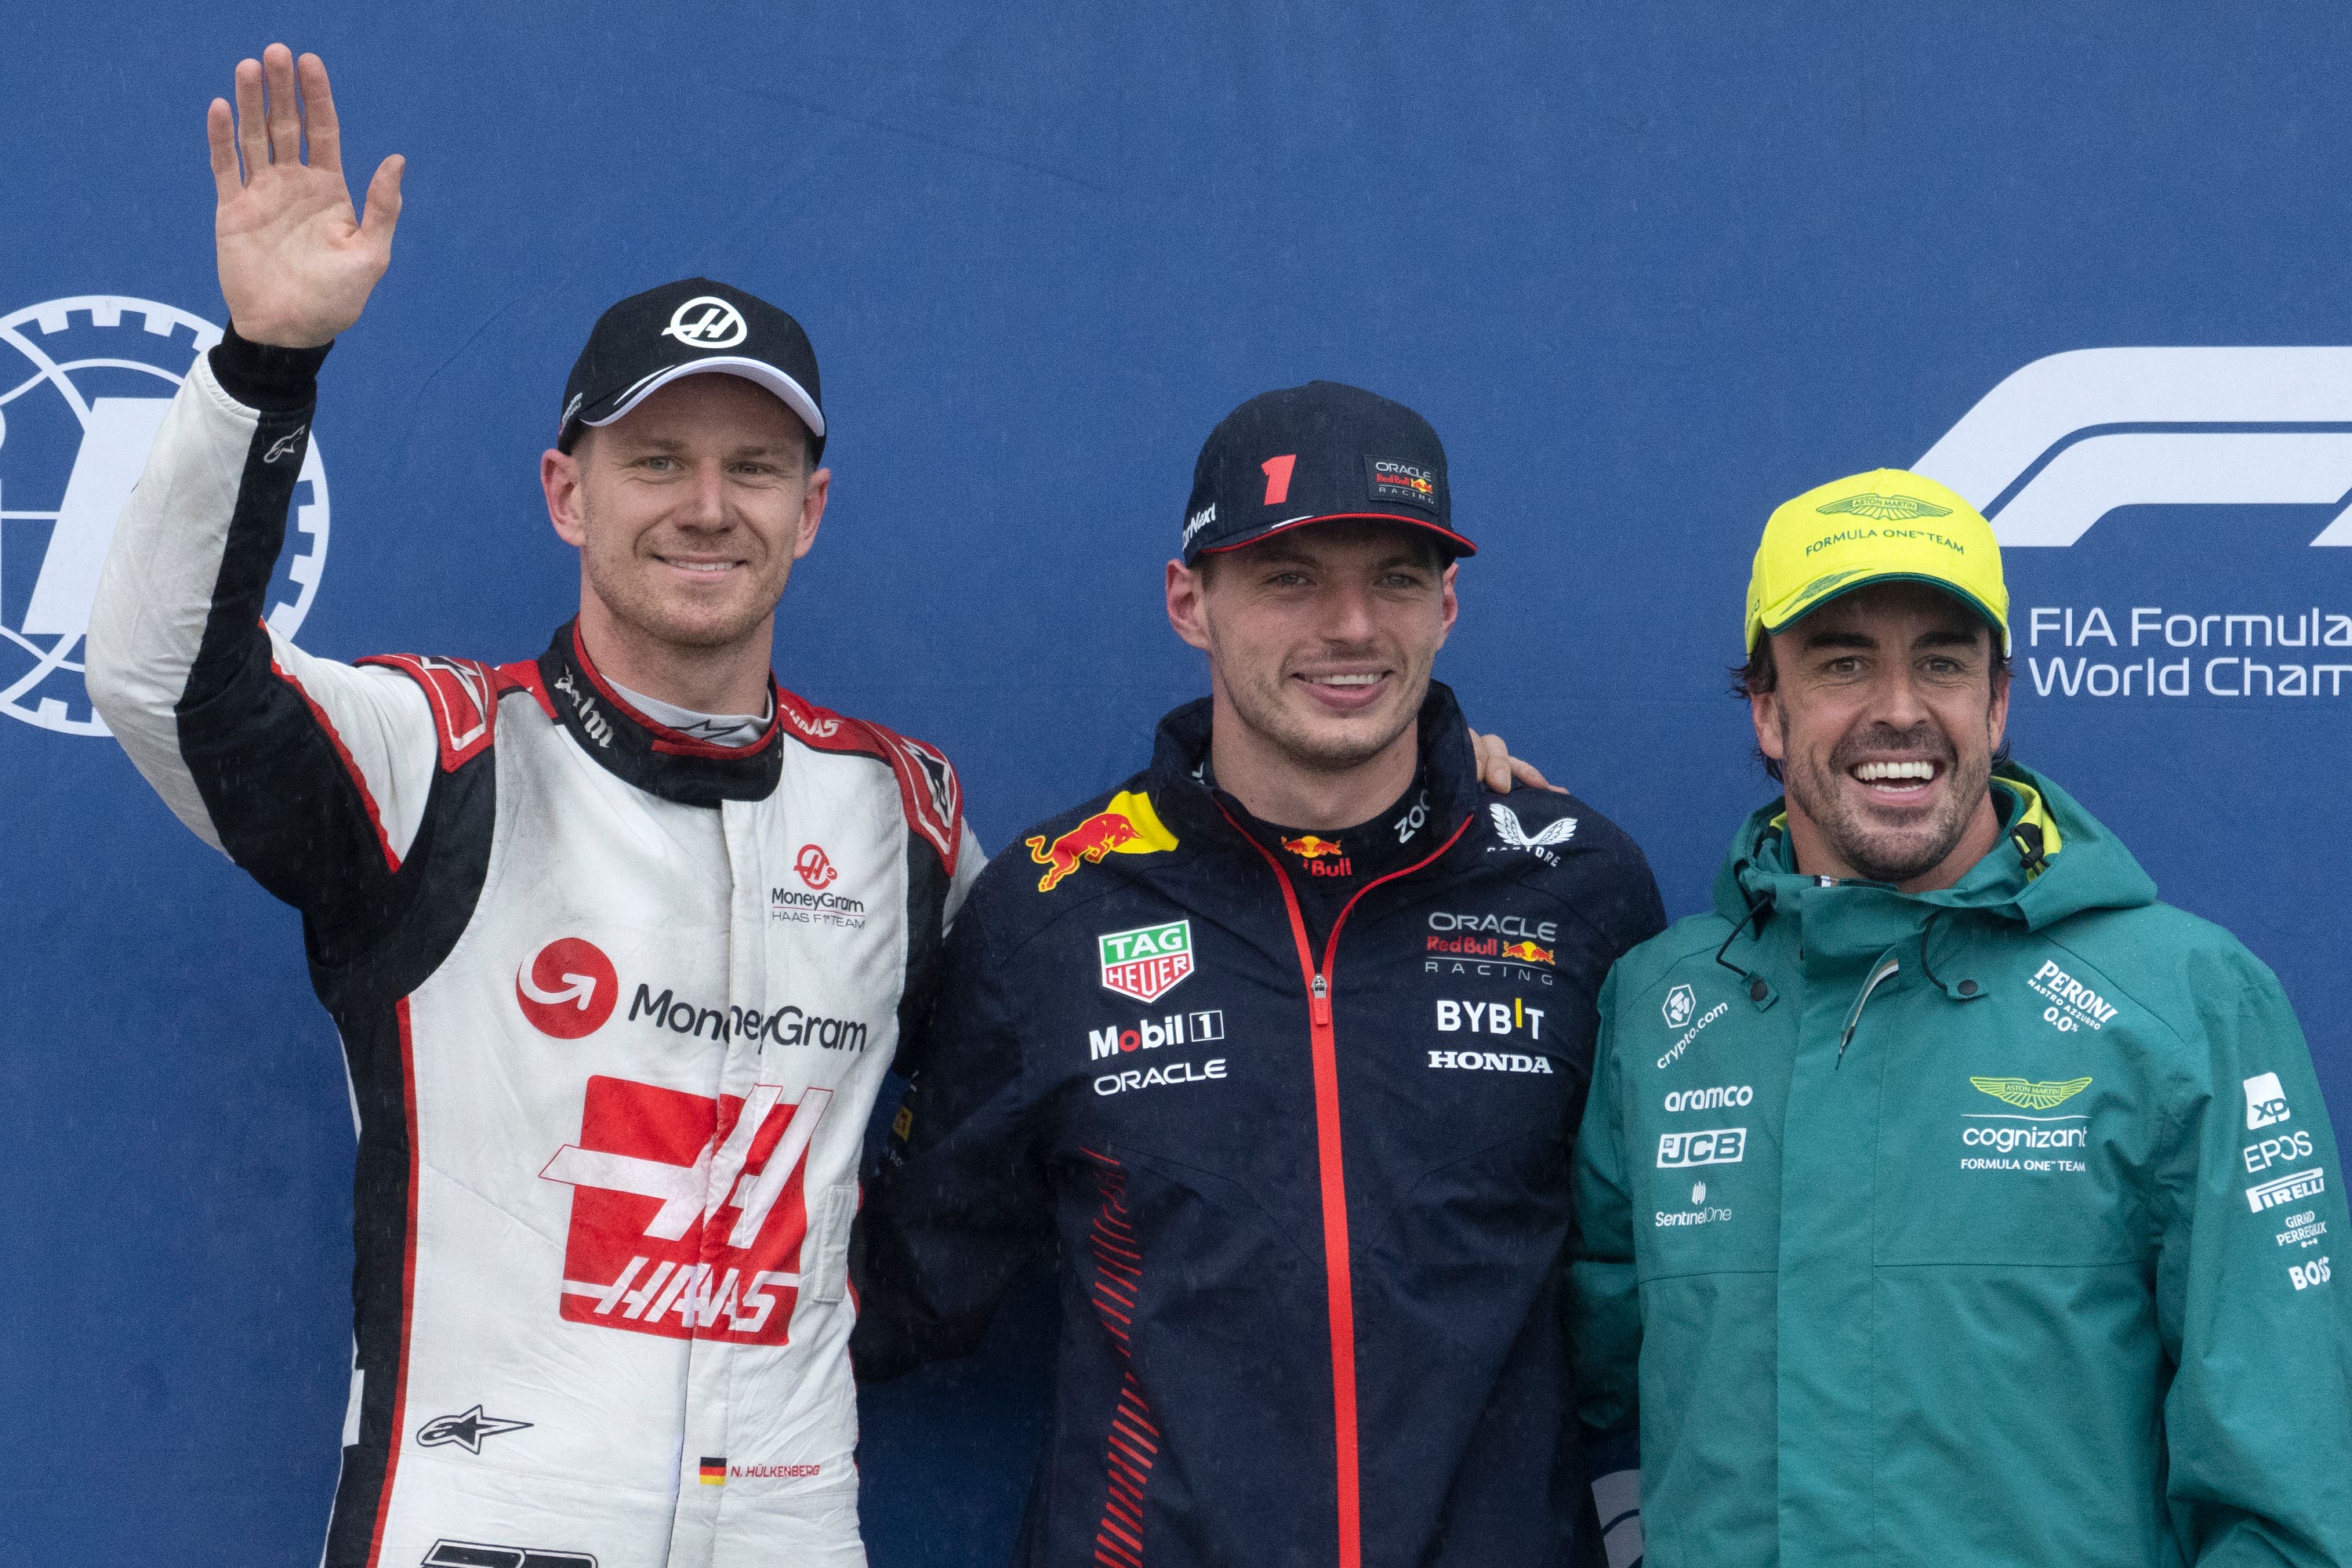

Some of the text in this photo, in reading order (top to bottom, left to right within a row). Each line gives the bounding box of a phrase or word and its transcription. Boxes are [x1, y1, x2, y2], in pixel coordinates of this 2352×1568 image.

[1261, 455, 1297, 505] 1
[1376, 463, 1432, 482] ORACLE
[1377, 474, 1410, 485] Red Bull
[1379, 487, 1434, 504] RACING
[1853, 496, 1915, 510] ASTON MARTIN
[1806, 529, 1878, 557] FORMULA
[1926, 533, 1965, 554] TEAM
[2031, 608, 2352, 647] FIA Formula
[2028, 657, 2190, 696] World
[1312, 858, 1352, 877] Bull
[771, 887, 864, 913] MoneyGram
[772, 911, 810, 923] HAAS
[830, 915, 866, 930] TEAM
[1428, 912, 1558, 942] ORACLE
[1108, 928, 1181, 960] TAG
[1427, 936, 1497, 956] Red Bull
[1109, 956, 1187, 996] HEUER
[1425, 961, 1552, 985] RACING
[2027, 978, 2101, 1030] NASTRO AZZURRO
[2034, 960, 2118, 1023] PERONI
[1437, 998, 1544, 1040] BYBIT
[2043, 1007, 2079, 1033] 0.0%
[1089, 1015, 1184, 1060] Mobil
[1657, 1002, 1729, 1069] crypto.com
[1428, 1051, 1553, 1074] HONDA
[1094, 1058, 1228, 1096] ORACLE
[2005, 1084, 2060, 1095] ASTON MARTIN
[1664, 1086, 1754, 1112] aramco
[1661, 1132, 1742, 1164] JCB
[1962, 1127, 2087, 1153] cognizant
[2243, 1131, 2313, 1174] EPOS
[1961, 1159, 2020, 1170] FORMULA
[2058, 1160, 2086, 1172] TEAM
[2245, 1167, 2325, 1214] PIRELLI
[1655, 1207, 1732, 1227] SentinelOne
[2288, 1256, 2331, 1290] BOSS
[562, 1257, 800, 1332] HAAS
[731, 1463, 820, 1478] N. HÜLKENBERG
